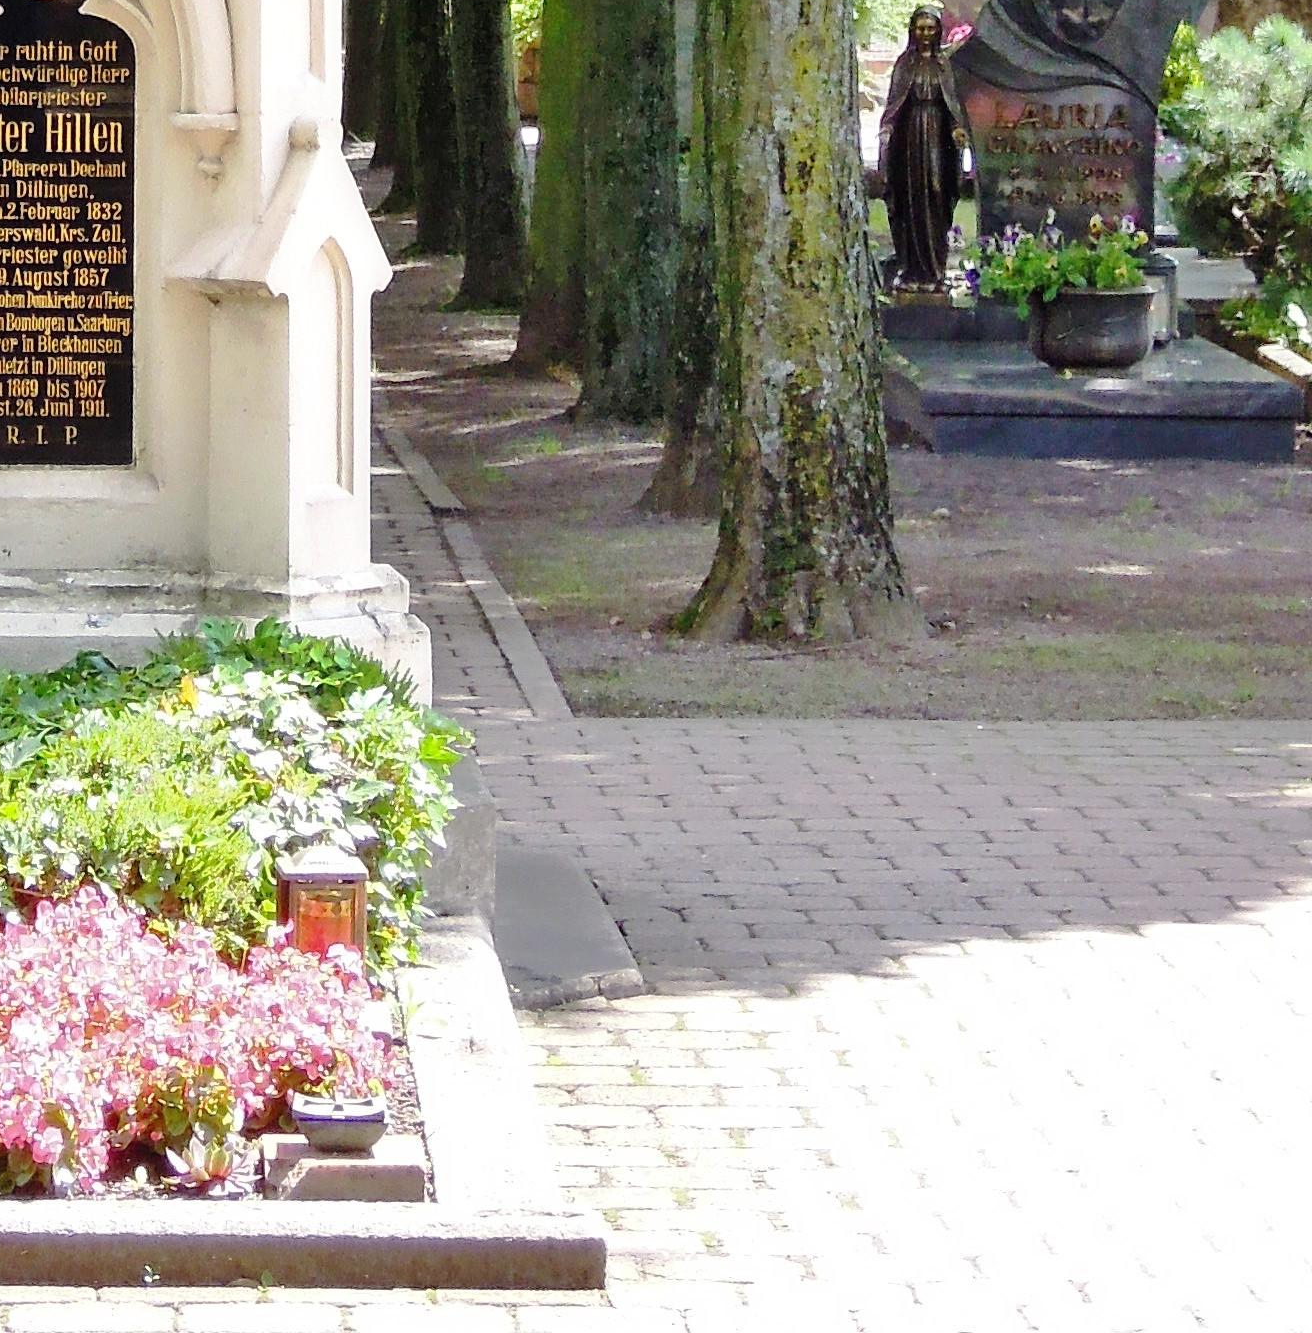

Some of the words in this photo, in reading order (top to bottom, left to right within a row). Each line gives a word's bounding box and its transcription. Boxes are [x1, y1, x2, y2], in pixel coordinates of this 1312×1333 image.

[15, 39, 55, 61] ruht
[57, 39, 73, 61] in
[79, 39, 118, 61] Gott
[90, 64, 130, 83] Herr
[44, 111, 124, 153] Hillen
[2, 158, 58, 177] Pfarrer
[71, 158, 128, 177] Dechant
[15, 180, 95, 202] Dillingen.
[85, 202, 123, 220] 1832
[62, 246, 128, 269] geweiht
[11, 267, 70, 291] August
[72, 267, 110, 286] 1857
[27, 290, 86, 309] Domkirche
[87, 290, 103, 309] zu
[21, 334, 35, 353] in
[37, 334, 123, 353] Bleckhausen
[31, 356, 44, 375] in
[47, 356, 106, 379] Dillingen
[7, 378, 39, 397] 1869
[46, 378, 70, 397] bis
[73, 378, 106, 397] 1907
[39, 399, 74, 417] Juni
